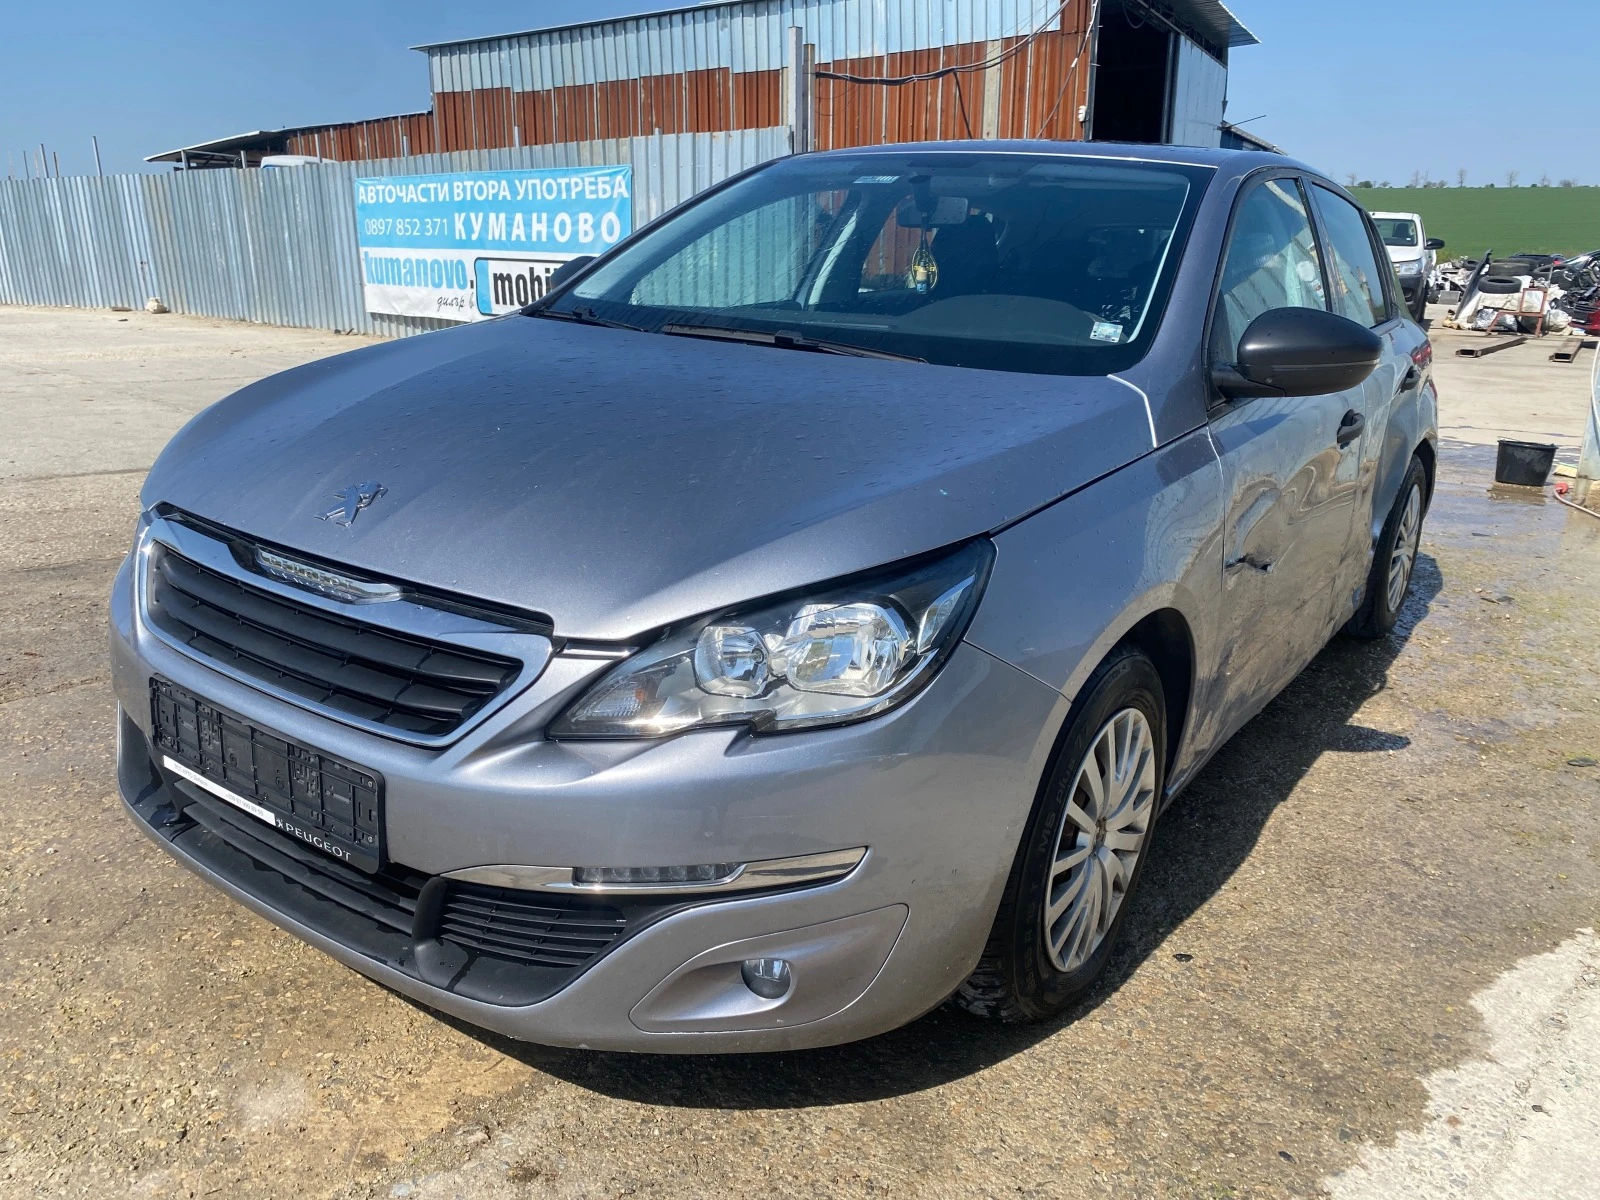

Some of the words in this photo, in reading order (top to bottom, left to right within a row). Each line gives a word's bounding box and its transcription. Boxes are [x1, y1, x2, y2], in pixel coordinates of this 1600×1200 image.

[358, 182, 450, 204] АВТОЧАСТИ
[453, 180, 512, 202] ВТОРА
[515, 175, 629, 201] УПОТРЕБА
[364, 218, 393, 236] 0897
[396, 218, 421, 236] 852
[424, 218, 449, 236] 371
[454, 212, 621, 244] КУМАНОВО
[493, 266, 559, 307] mobi
[269, 555, 355, 588] PEUGEOT
[285, 822, 352, 861] PEUGEOT
